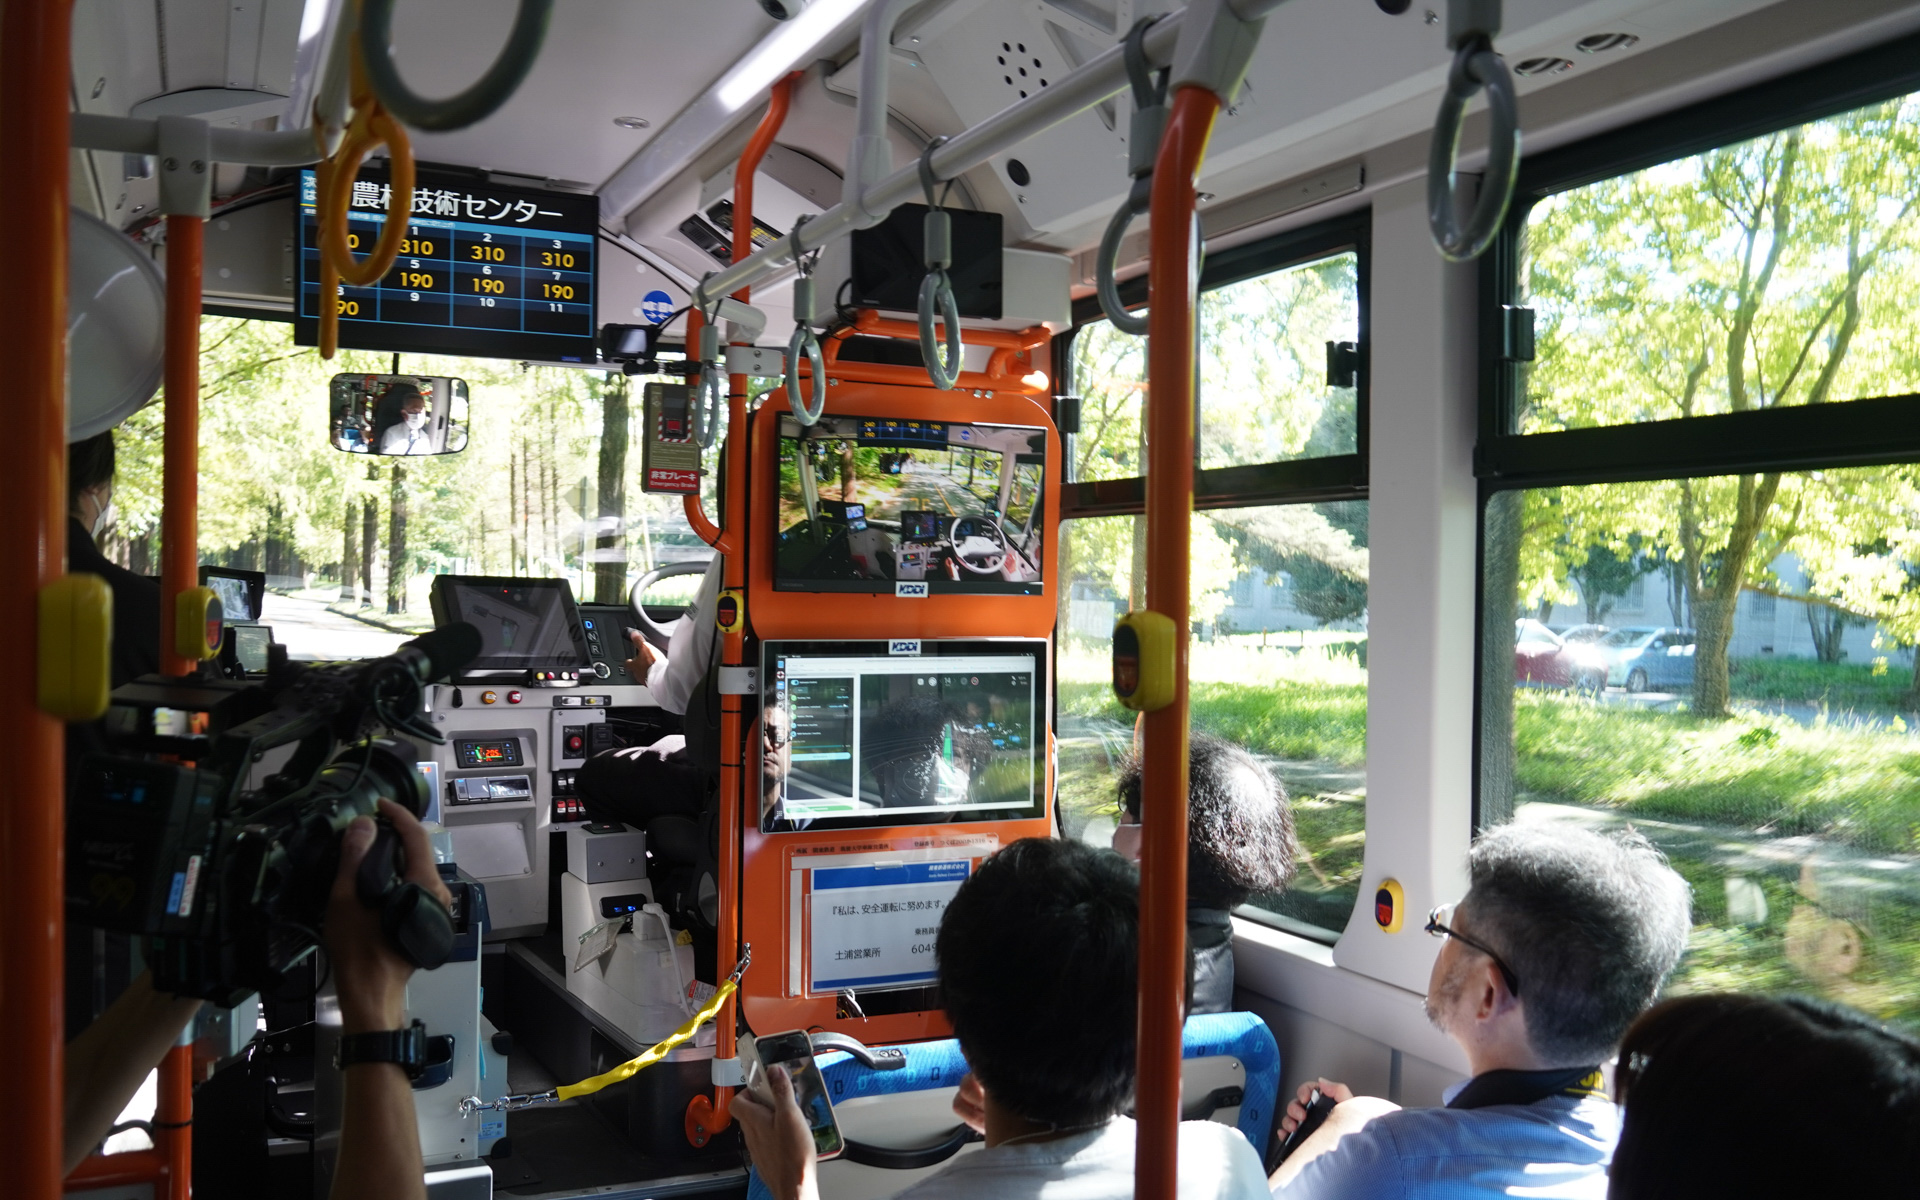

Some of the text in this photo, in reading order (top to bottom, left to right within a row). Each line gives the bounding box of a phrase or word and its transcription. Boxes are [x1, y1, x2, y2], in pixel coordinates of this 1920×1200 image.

[411, 226, 419, 236] 1
[482, 233, 492, 243] 2
[399, 239, 434, 256] 310
[552, 240, 562, 249] 3
[470, 245, 505, 262] 310
[410, 259, 420, 269] 5
[541, 252, 575, 268] 310
[482, 266, 492, 275] 6
[400, 271, 434, 288] 190
[552, 271, 562, 281] 7
[472, 278, 505, 294] 190
[542, 284, 574, 300] 190
[410, 293, 420, 303] 9
[479, 298, 495, 308] 10
[337, 300, 360, 316] 90
[549, 303, 563, 313] 11
[651, 471, 697, 481] 非常ブレーキ
[650, 480, 680, 488] Emergency
[899, 584, 925, 594] KDDI
[591, 645, 600, 654] R
[892, 642, 918, 652] KDDI
[834, 947, 881, 960] 土浦営業所
